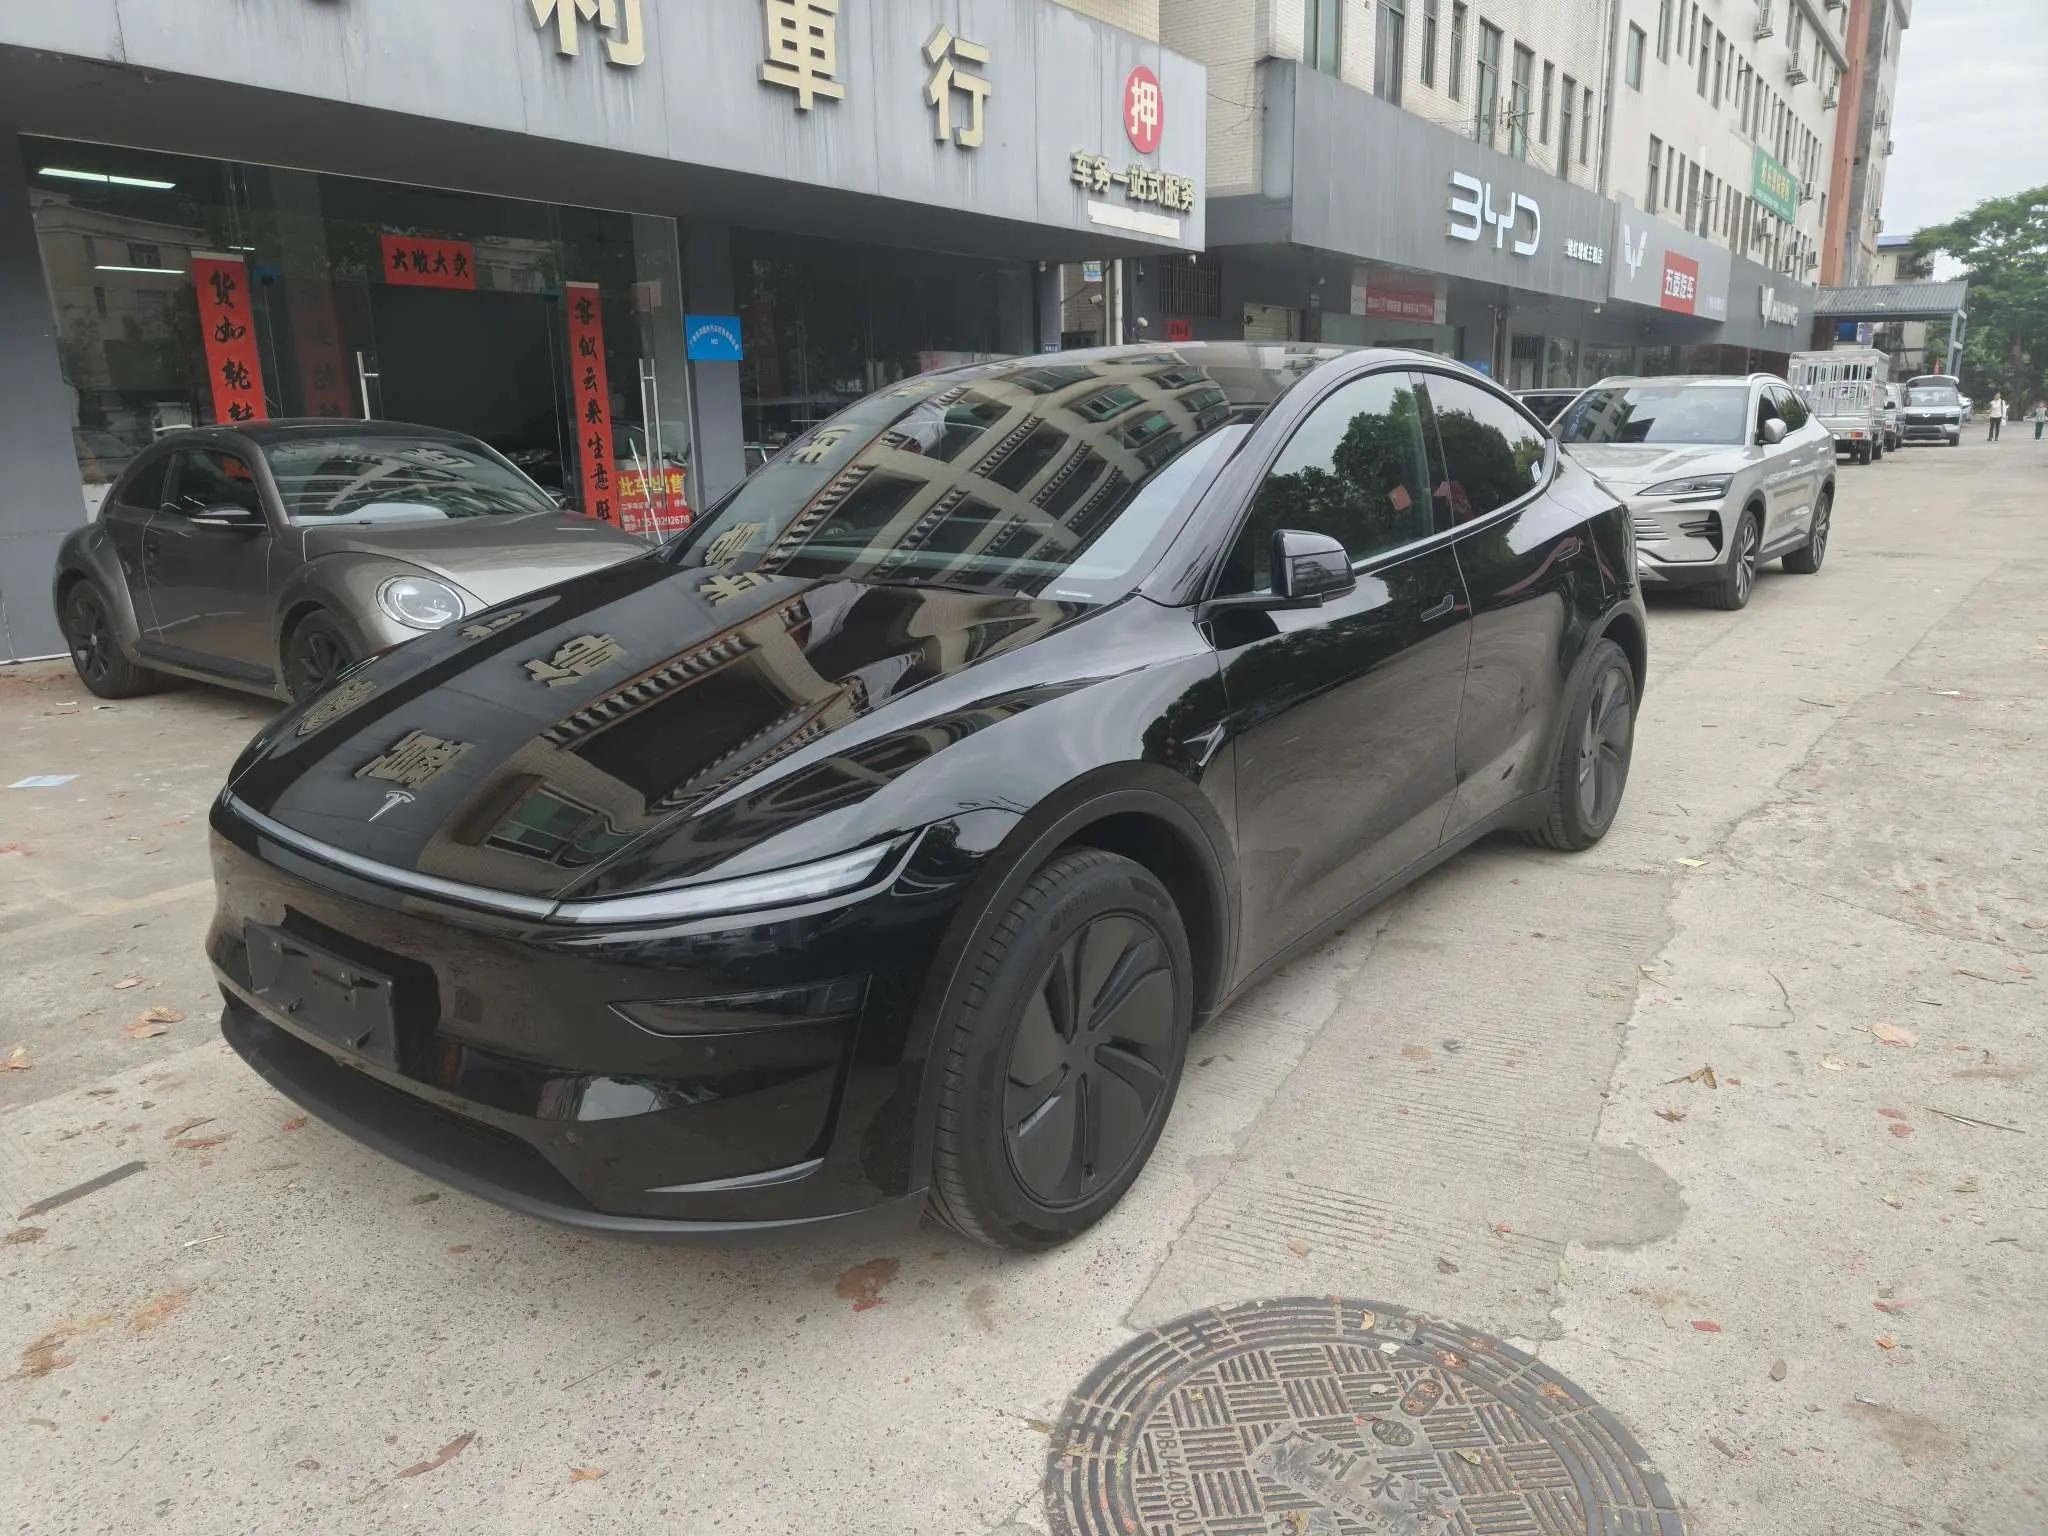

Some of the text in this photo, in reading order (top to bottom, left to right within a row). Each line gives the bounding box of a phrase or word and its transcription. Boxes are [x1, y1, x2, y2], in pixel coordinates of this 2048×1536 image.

[1130, 76, 1159, 141] 押
[1071, 150, 1197, 213] 车务一站式服务
[1448, 170, 1541, 256] BYD
[1664, 268, 1696, 300] 五菱汽车
